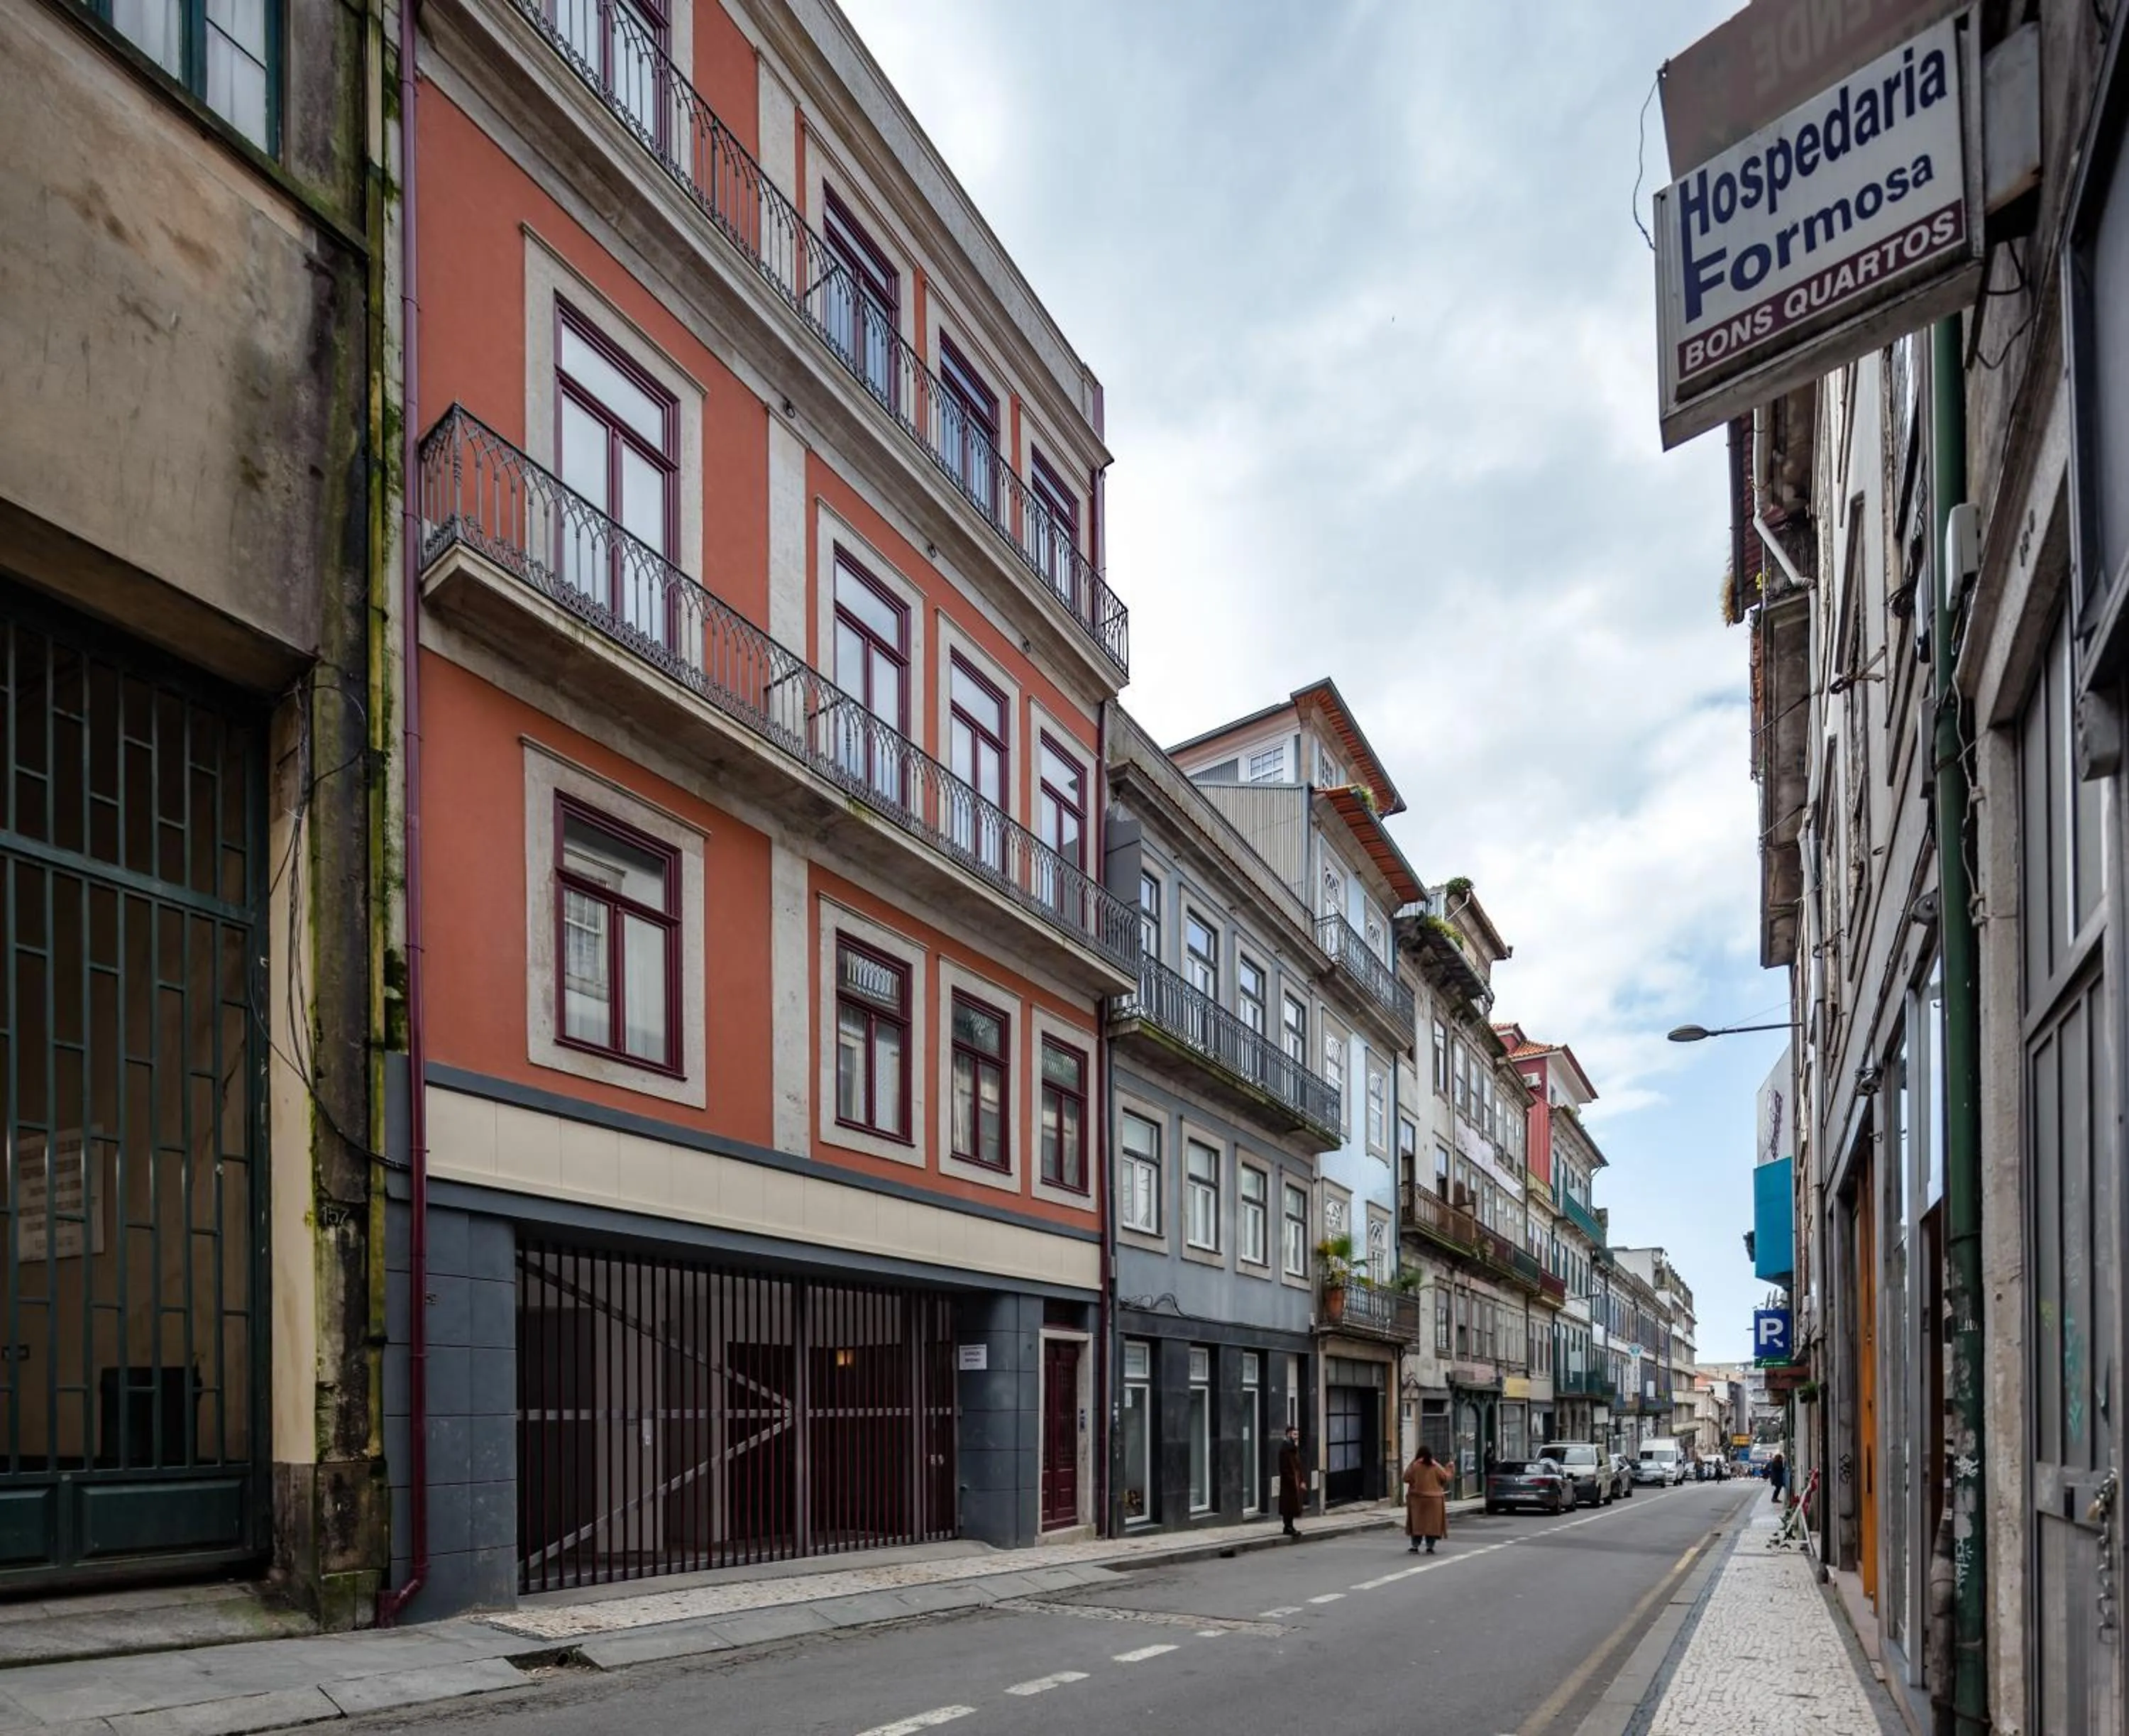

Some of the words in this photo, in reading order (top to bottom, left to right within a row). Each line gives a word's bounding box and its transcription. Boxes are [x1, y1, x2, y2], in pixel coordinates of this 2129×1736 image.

[1678, 47, 1947, 236] Hospedaria
[1682, 154, 1934, 324] Formosa
[1685, 305, 1773, 371] BONS
[1783, 211, 1955, 319] QUARTOS
[321, 1206, 350, 1225] 157
[1759, 1318, 1783, 1345] P
